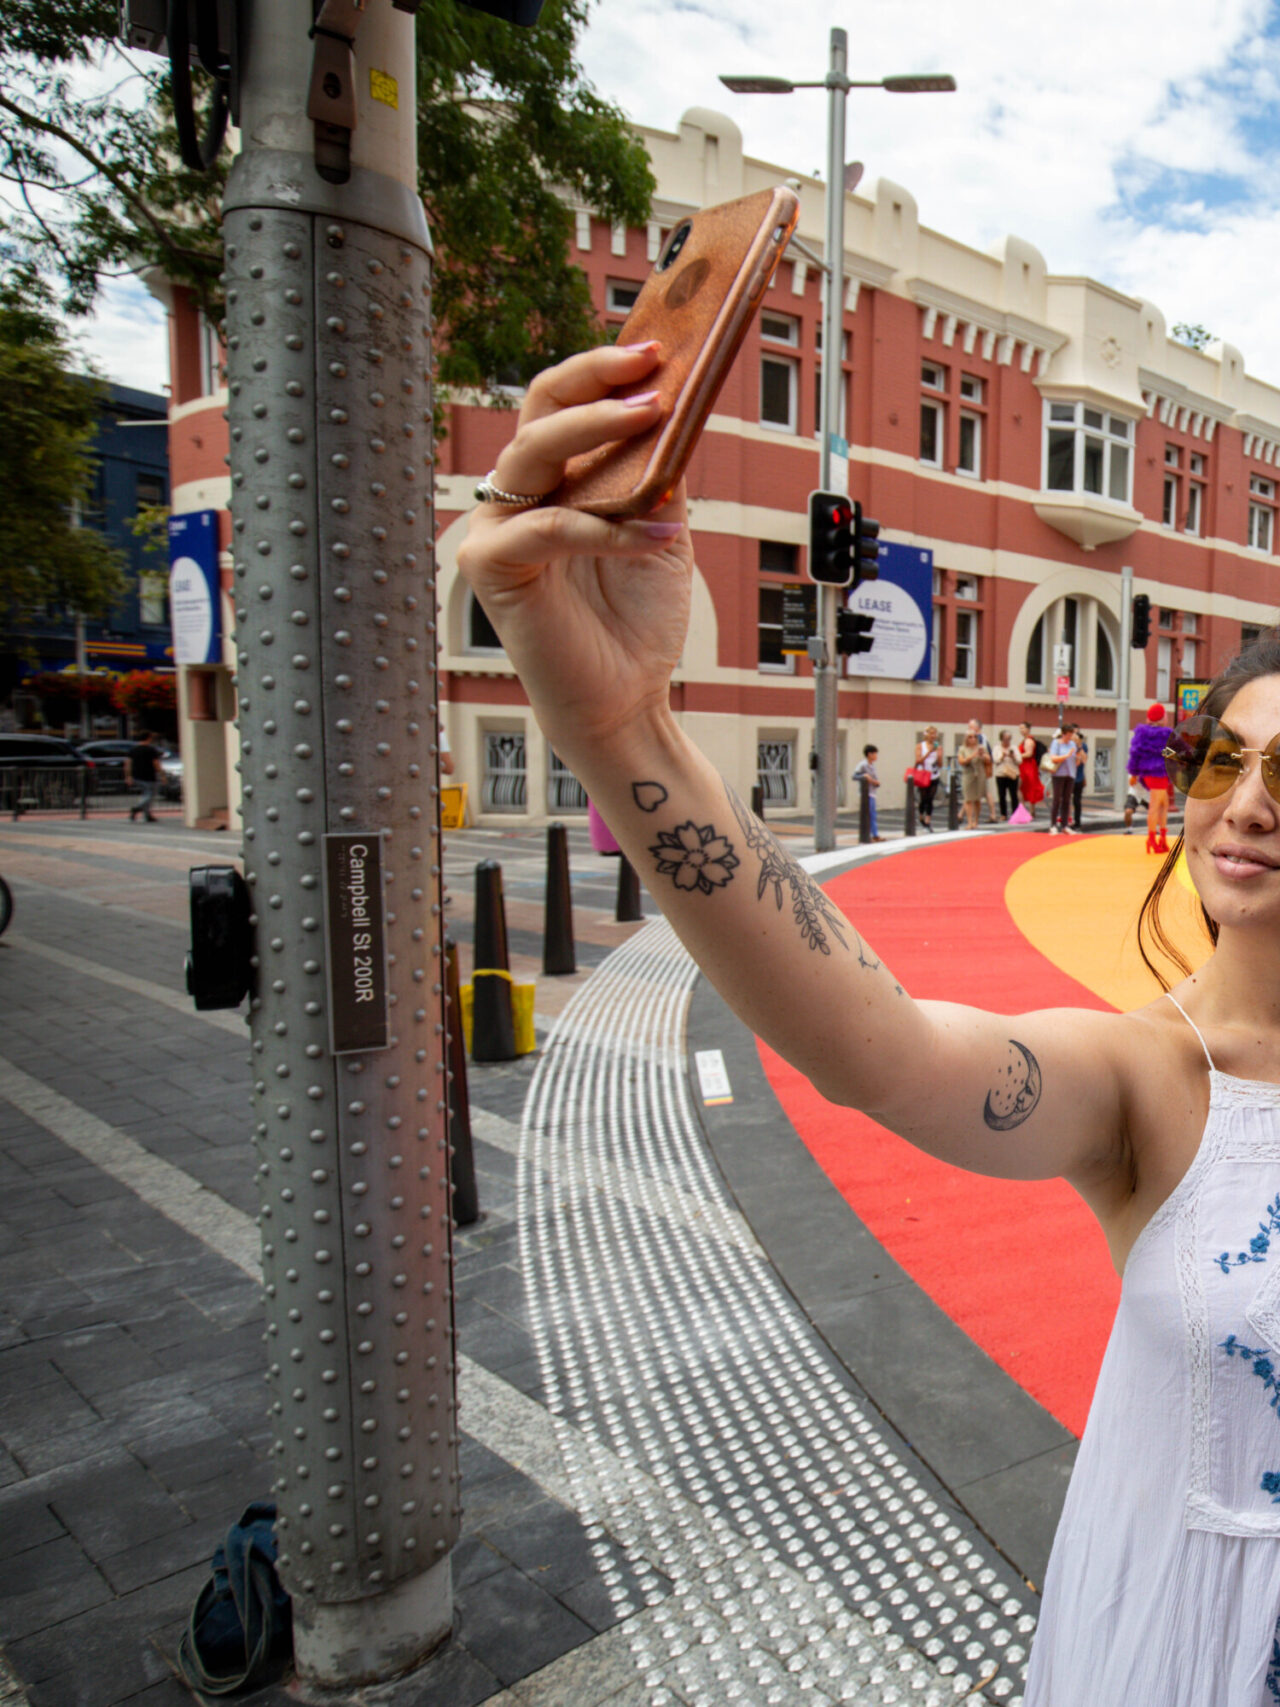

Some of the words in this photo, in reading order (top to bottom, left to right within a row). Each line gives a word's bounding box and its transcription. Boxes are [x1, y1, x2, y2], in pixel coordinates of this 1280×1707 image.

[858, 597, 893, 613] LEASE
[347, 844, 371, 928] Campbell
[353, 932, 372, 952] St
[354, 956, 375, 1003] 200R
